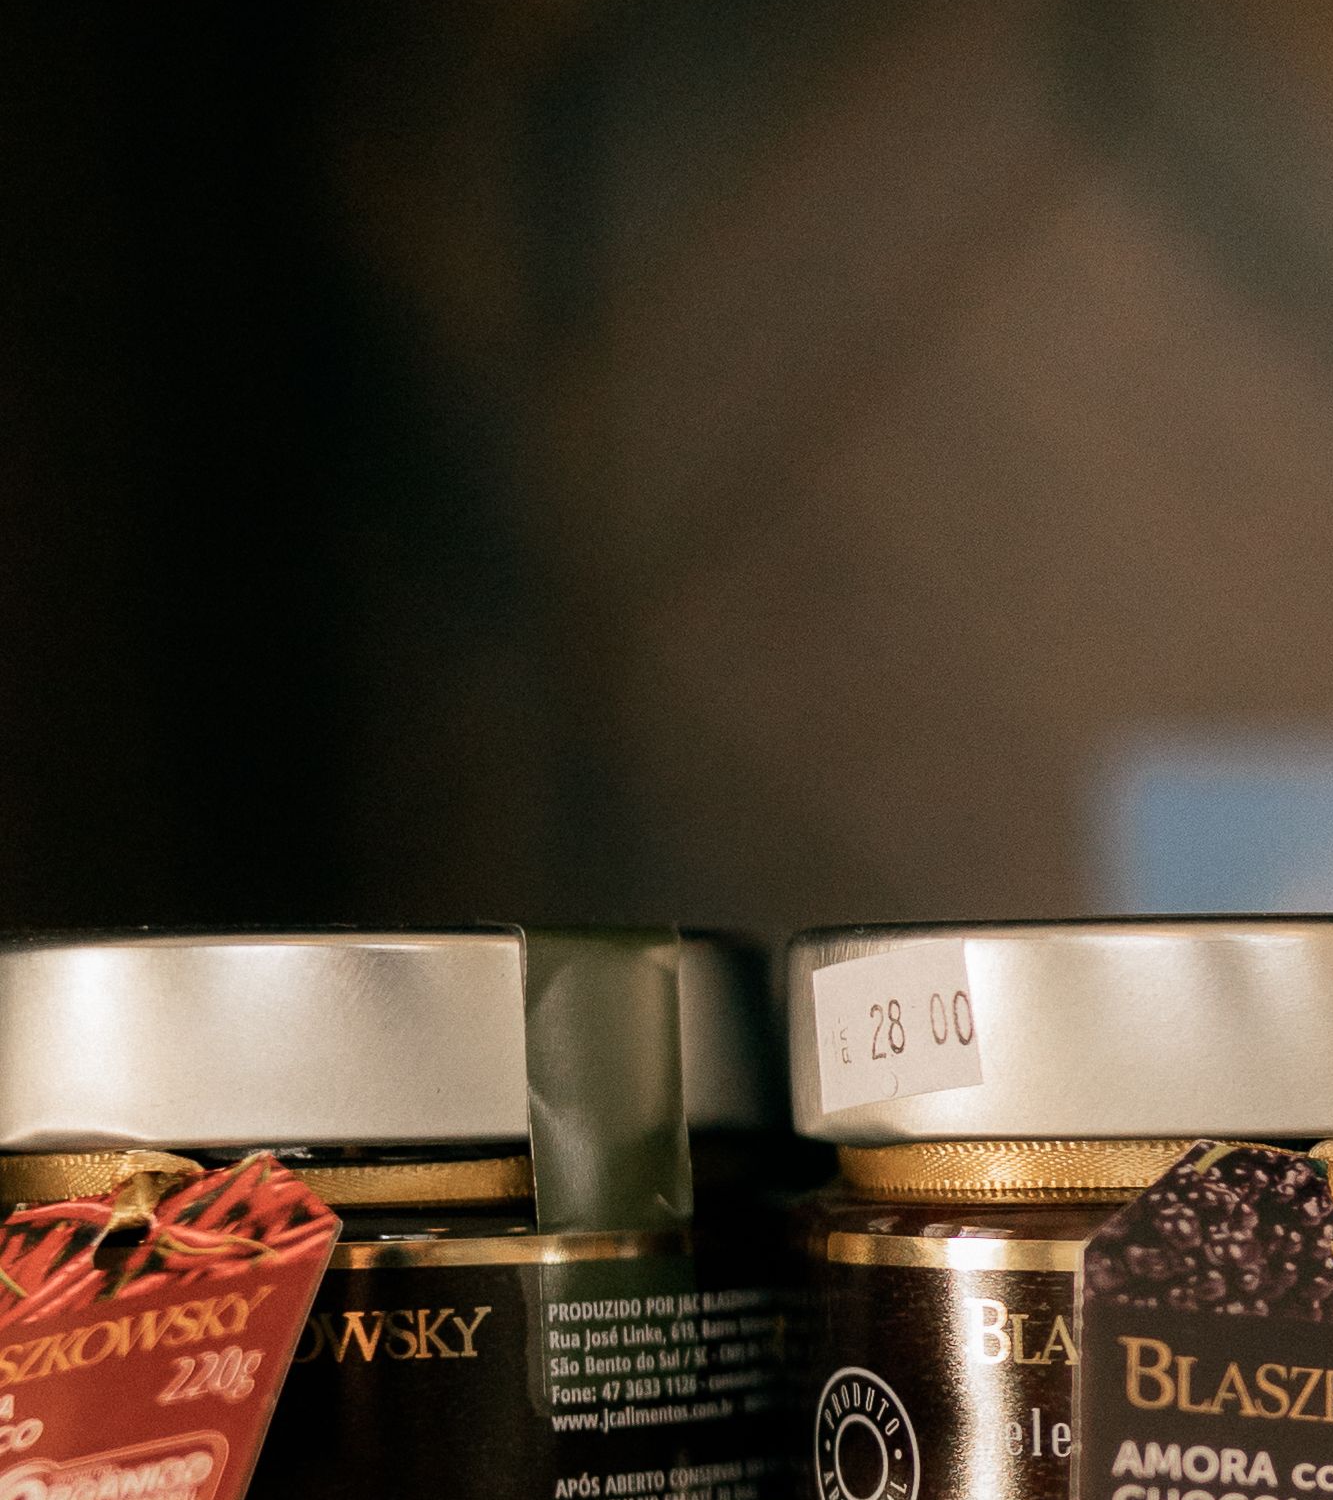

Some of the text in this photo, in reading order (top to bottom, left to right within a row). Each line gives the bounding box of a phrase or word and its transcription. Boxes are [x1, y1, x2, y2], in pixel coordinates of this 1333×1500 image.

[869, 998, 905, 1061] 28
[929, 989, 974, 1047] 00
[548, 1298, 641, 1323] PRODUZIDO
[646, 1295, 674, 1316] POR
[550, 1329, 581, 1350] Rua
[583, 1324, 618, 1352] José
[623, 1322, 667, 1346] Linke,
[155, 1344, 266, 1407] 220g
[550, 1356, 579, 1378] São
[585, 1353, 632, 1376] Bento
[636, 1350, 655, 1370] do
[659, 1348, 680, 1369] Sul
[552, 1384, 597, 1406] Fone:
[601, 1380, 621, 1401] 47
[823, 1380, 901, 1437] PRODUTO
[1003, 1406, 1073, 1458] ele
[1111, 1438, 1279, 1488] AMORA
[555, 1471, 601, 1500] APÓS
[605, 1469, 665, 1494] ABERTO
